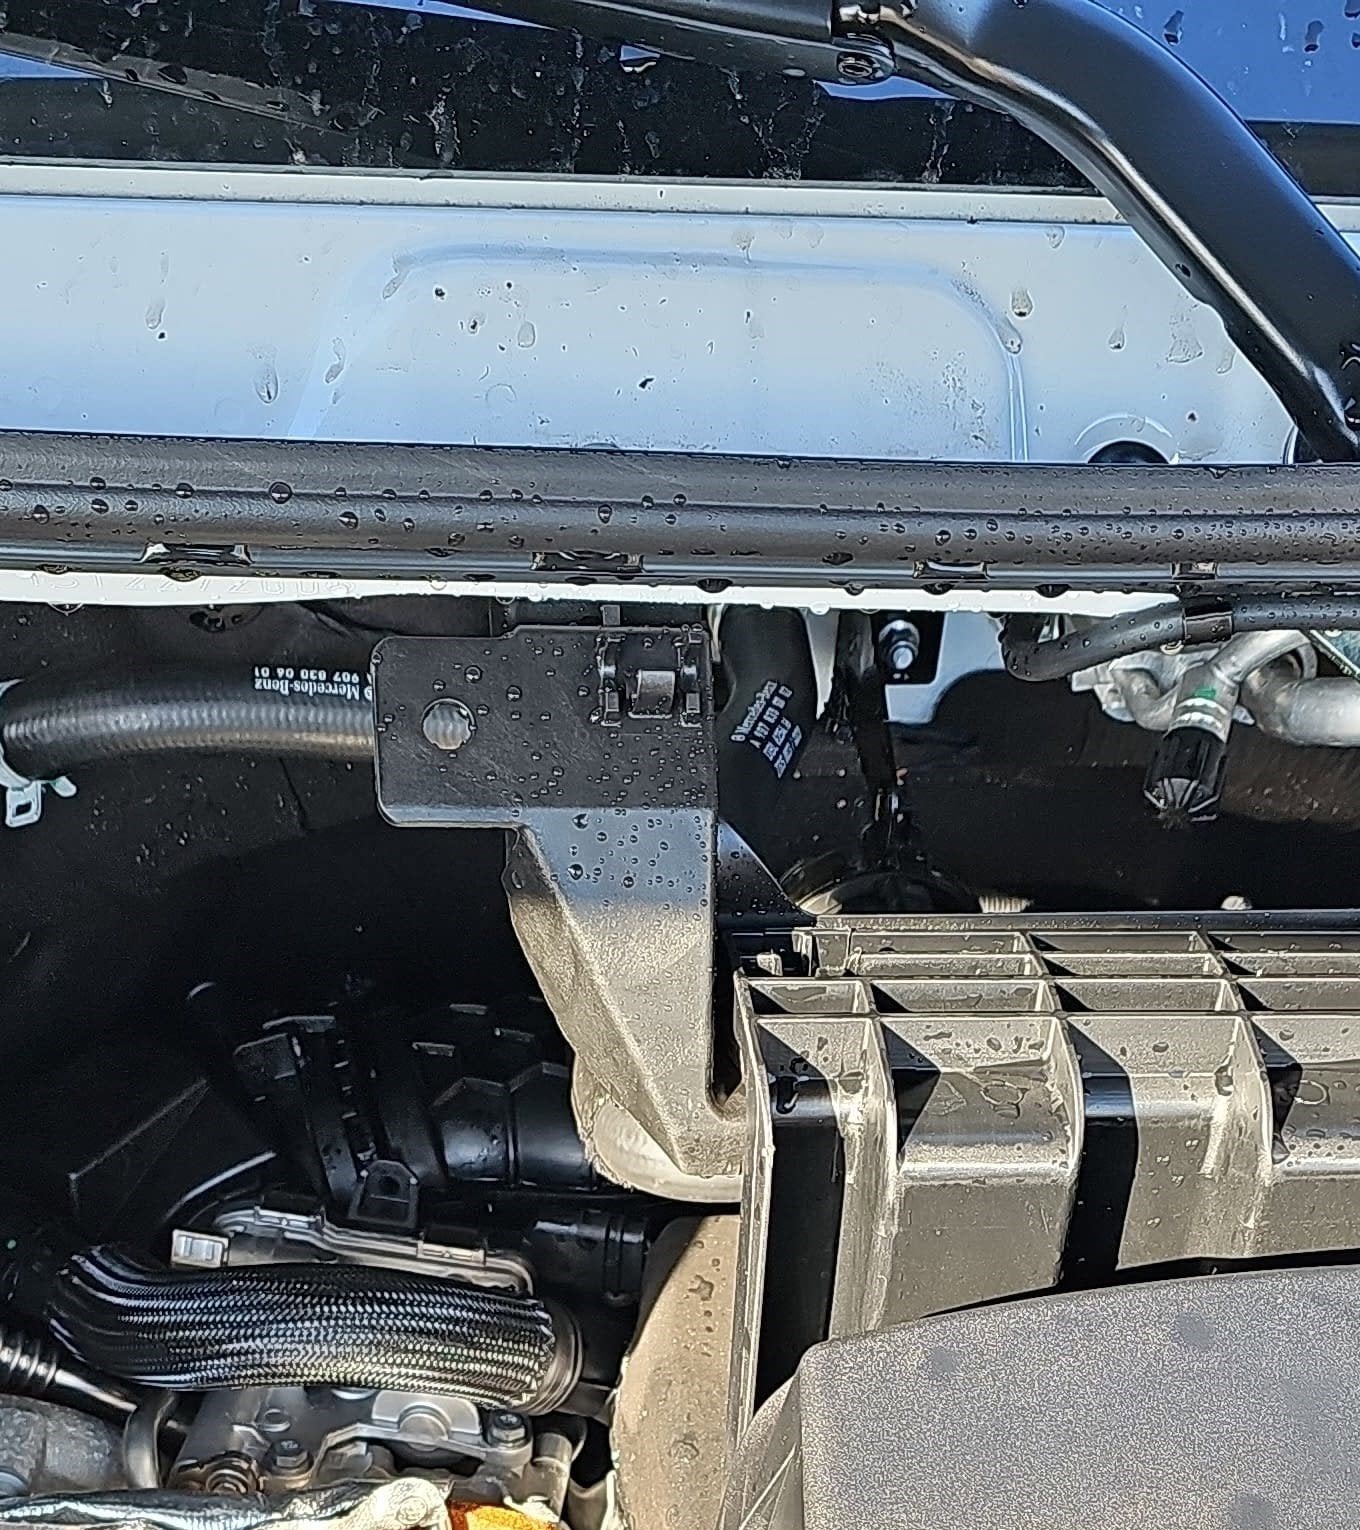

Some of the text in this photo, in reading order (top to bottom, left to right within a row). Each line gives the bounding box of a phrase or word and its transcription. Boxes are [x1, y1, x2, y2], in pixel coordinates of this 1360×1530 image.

[254, 666, 270, 678] 01
[333, 671, 360, 683] 907
[254, 678, 360, 700] Mercedes-Benz
